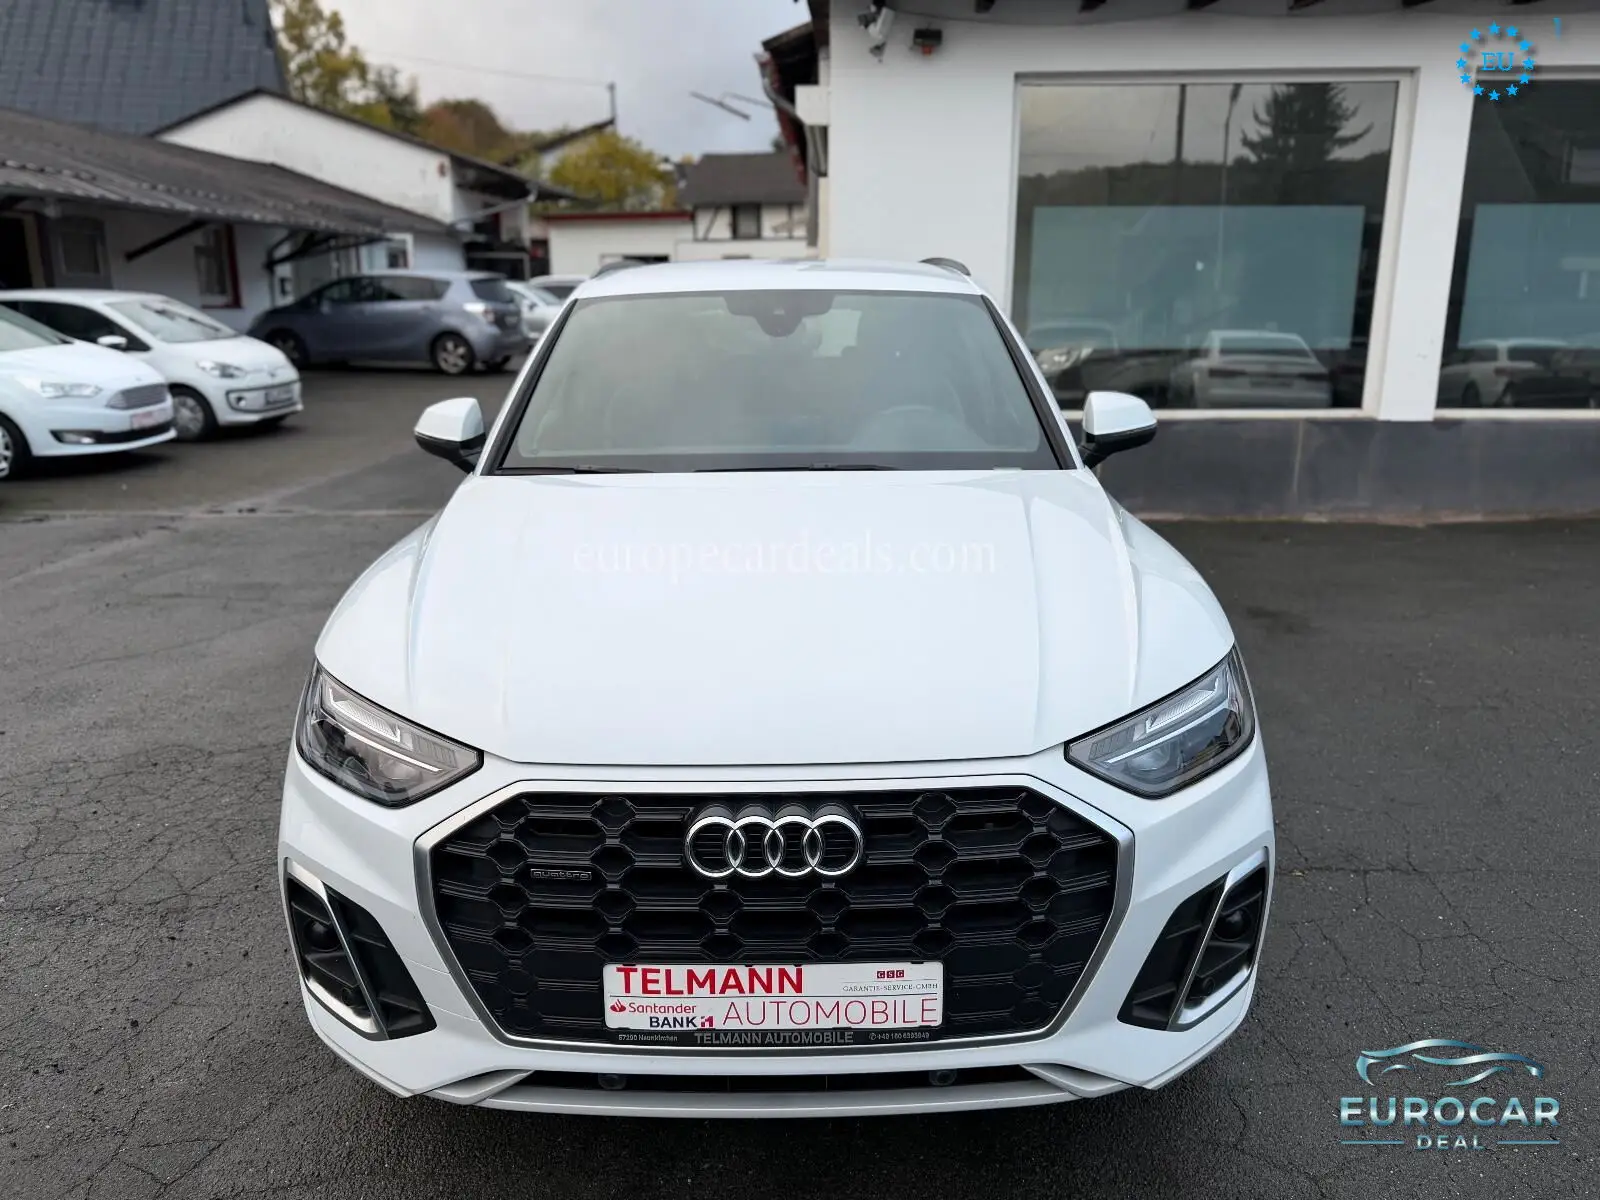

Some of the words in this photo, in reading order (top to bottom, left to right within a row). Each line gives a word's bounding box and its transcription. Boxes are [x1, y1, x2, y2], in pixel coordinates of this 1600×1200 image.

[876, 969, 905, 979] GSG
[616, 967, 803, 995] TELMANN
[628, 1002, 697, 1014] Santander
[722, 998, 938, 1026] AUTOMOBILE
[694, 1032, 762, 1044] TELMANN
[764, 1031, 854, 1044] AUTOMOBILE
